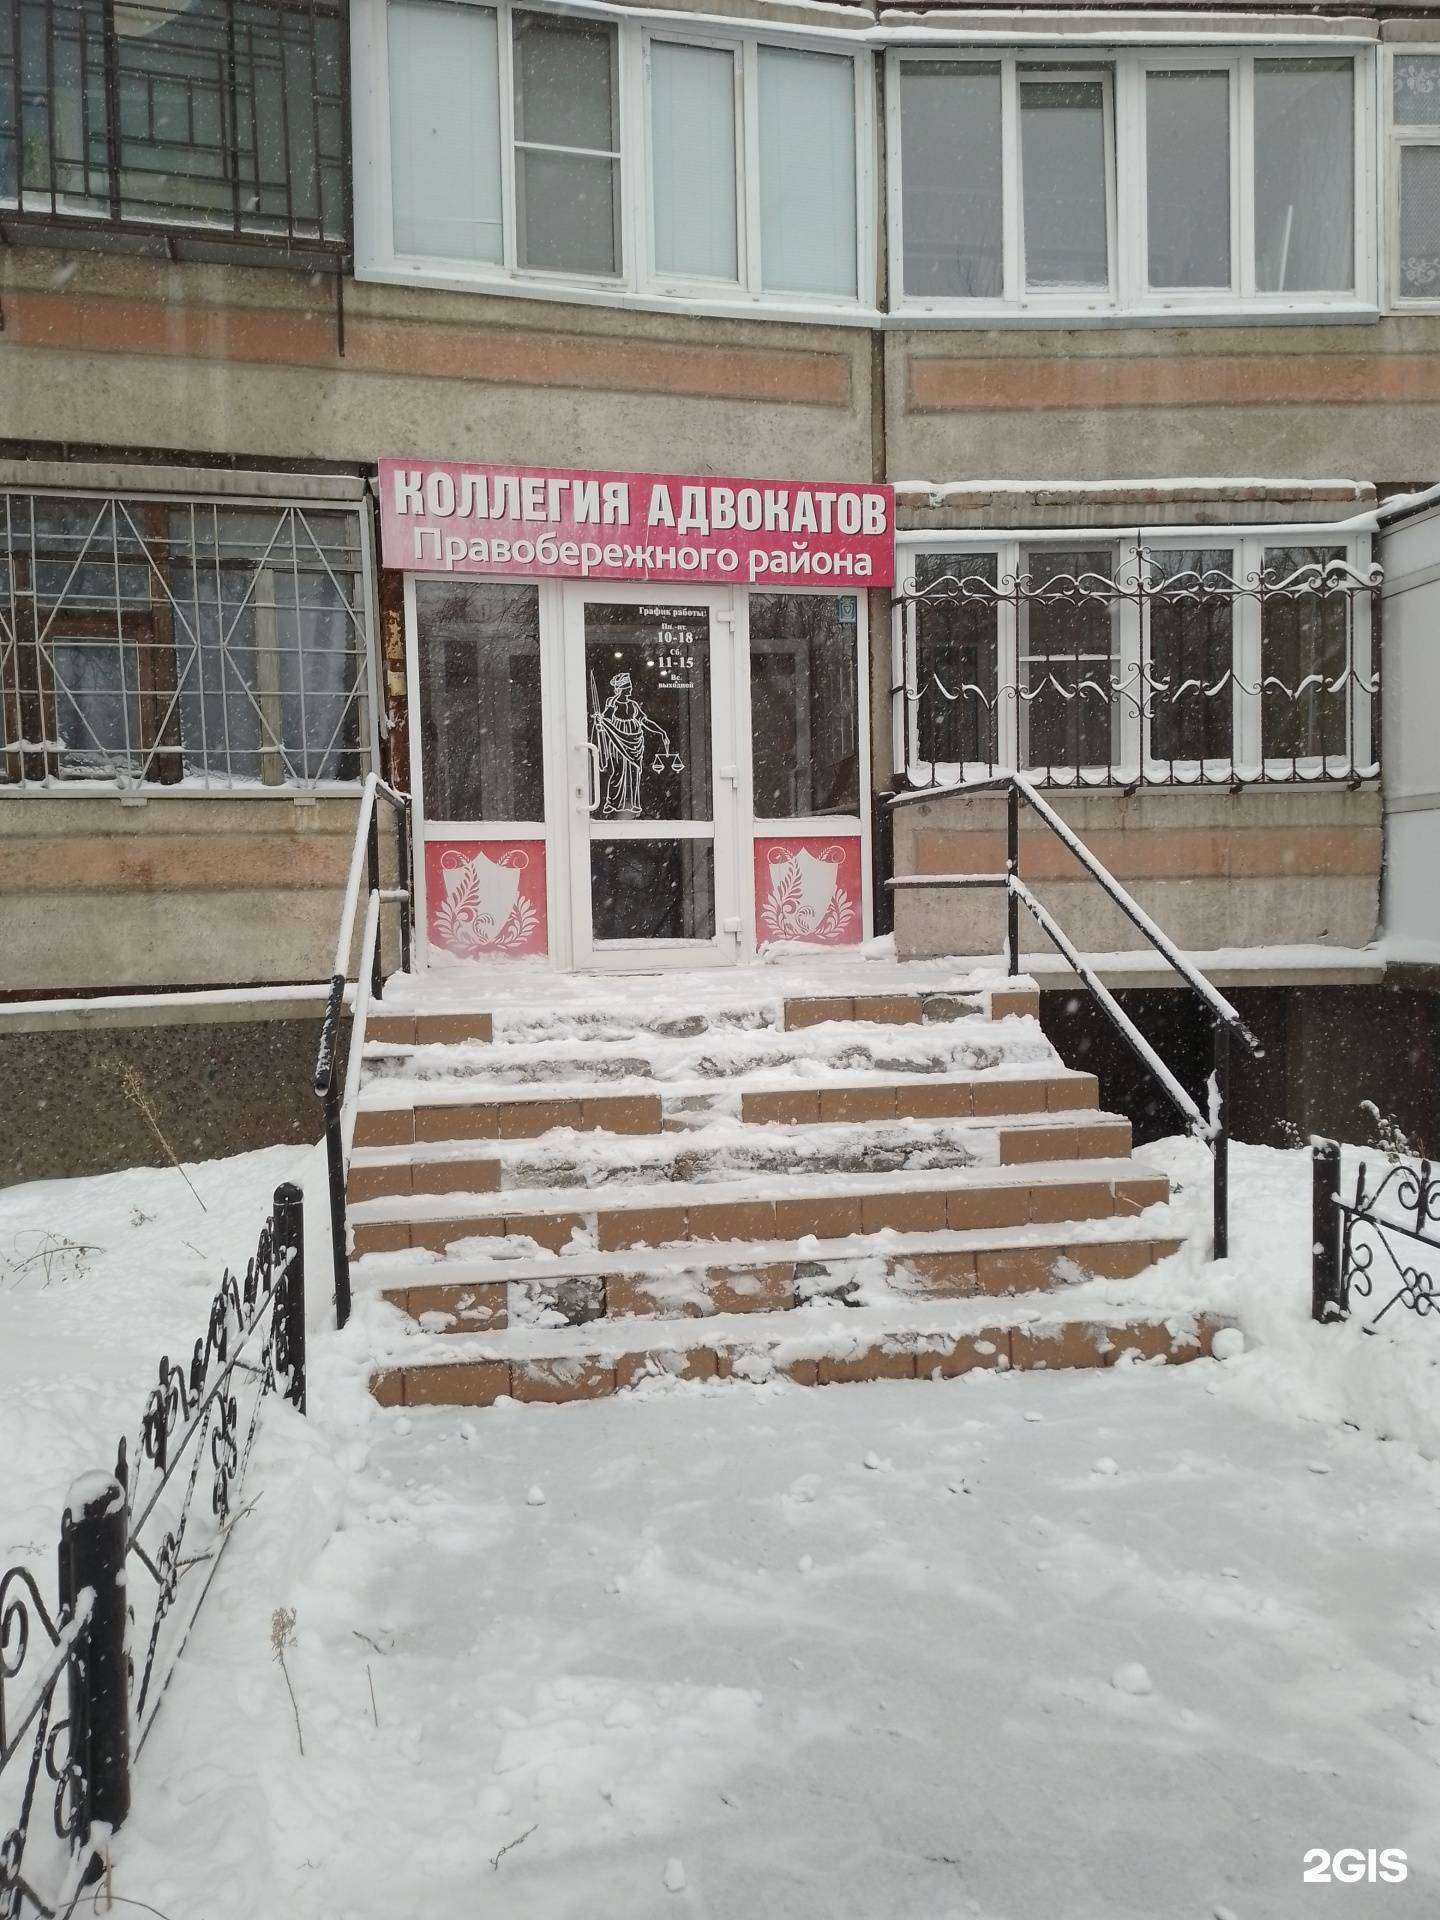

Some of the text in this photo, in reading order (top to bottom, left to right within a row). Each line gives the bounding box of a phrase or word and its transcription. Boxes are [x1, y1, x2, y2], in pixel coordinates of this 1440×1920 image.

[394, 469, 887, 536] КОЛЛЕГИЯ АДВОКАТОВ
[414, 526, 873, 582] Правобережного района
[639, 606, 671, 617] График
[658, 631, 694, 643] 10-18
[658, 656, 694, 668] 11-15
